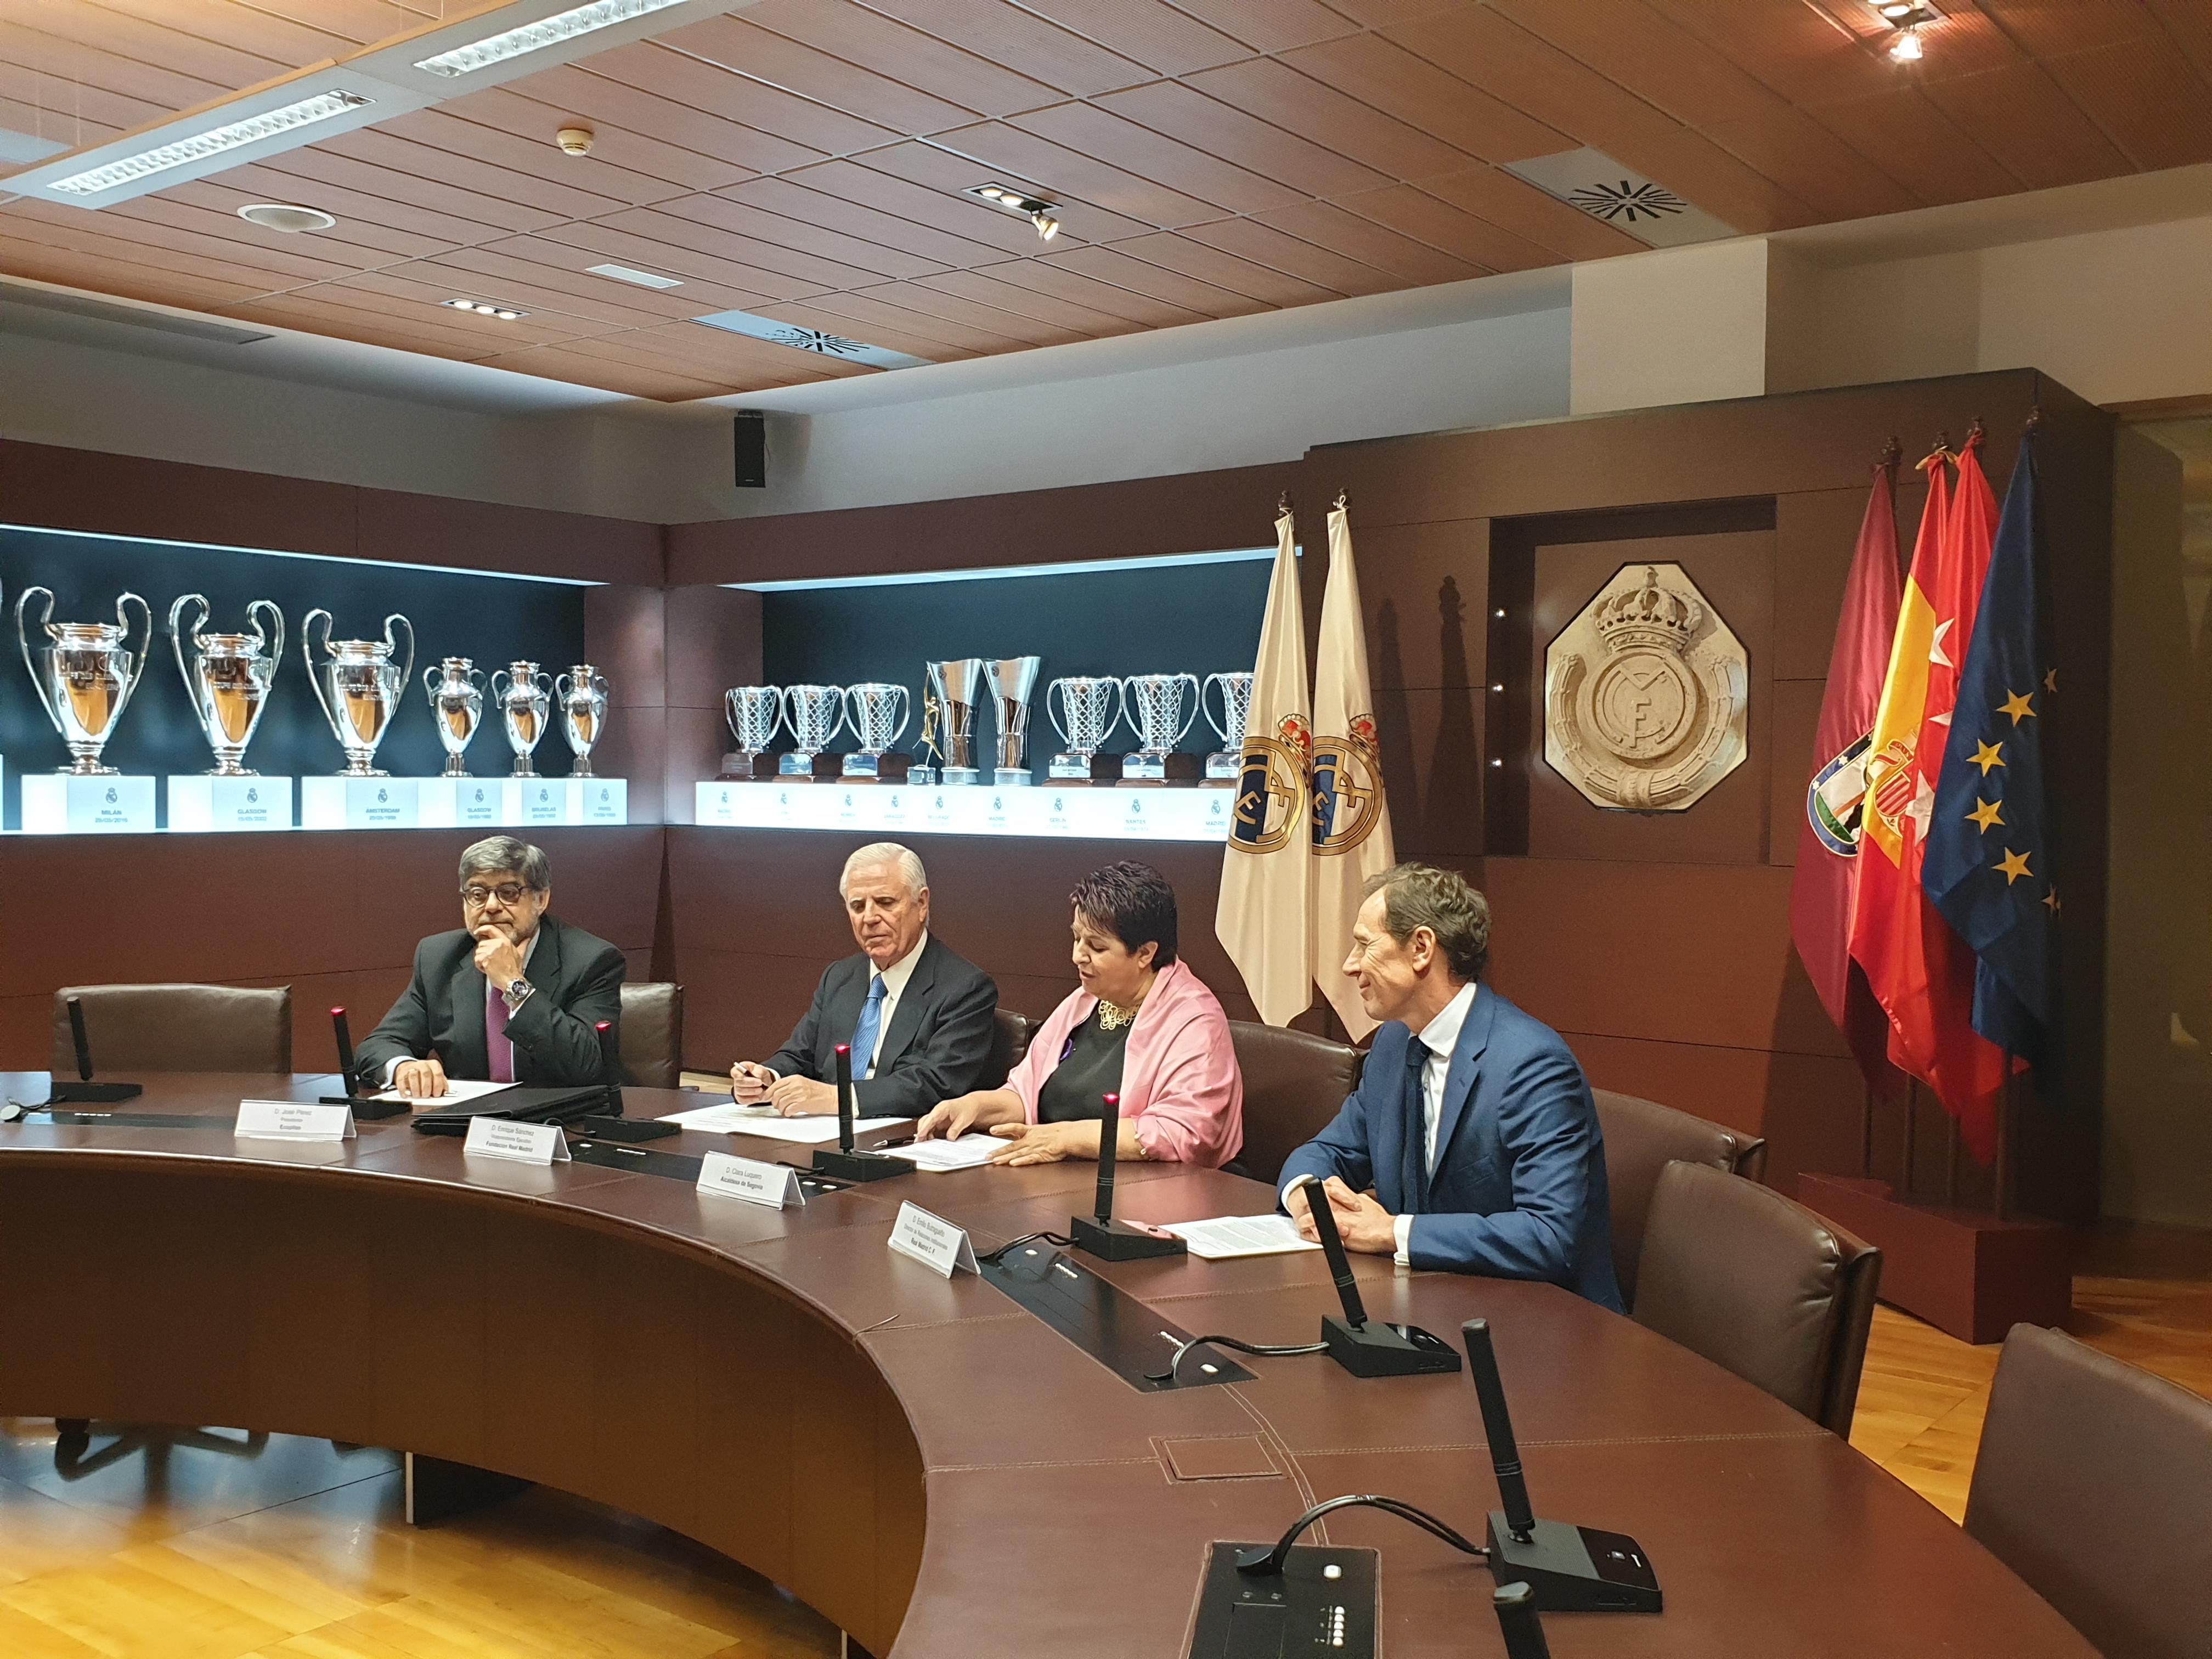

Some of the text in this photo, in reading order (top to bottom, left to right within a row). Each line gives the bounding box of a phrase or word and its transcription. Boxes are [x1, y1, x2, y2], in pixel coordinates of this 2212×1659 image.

[515, 1127, 534, 1136] Sánchez
[732, 1167, 743, 1176] Clara
[744, 1171, 762, 1180] Luquero
[720, 1176, 740, 1185] Alcaldesa
[747, 1181, 763, 1190] Segovia
